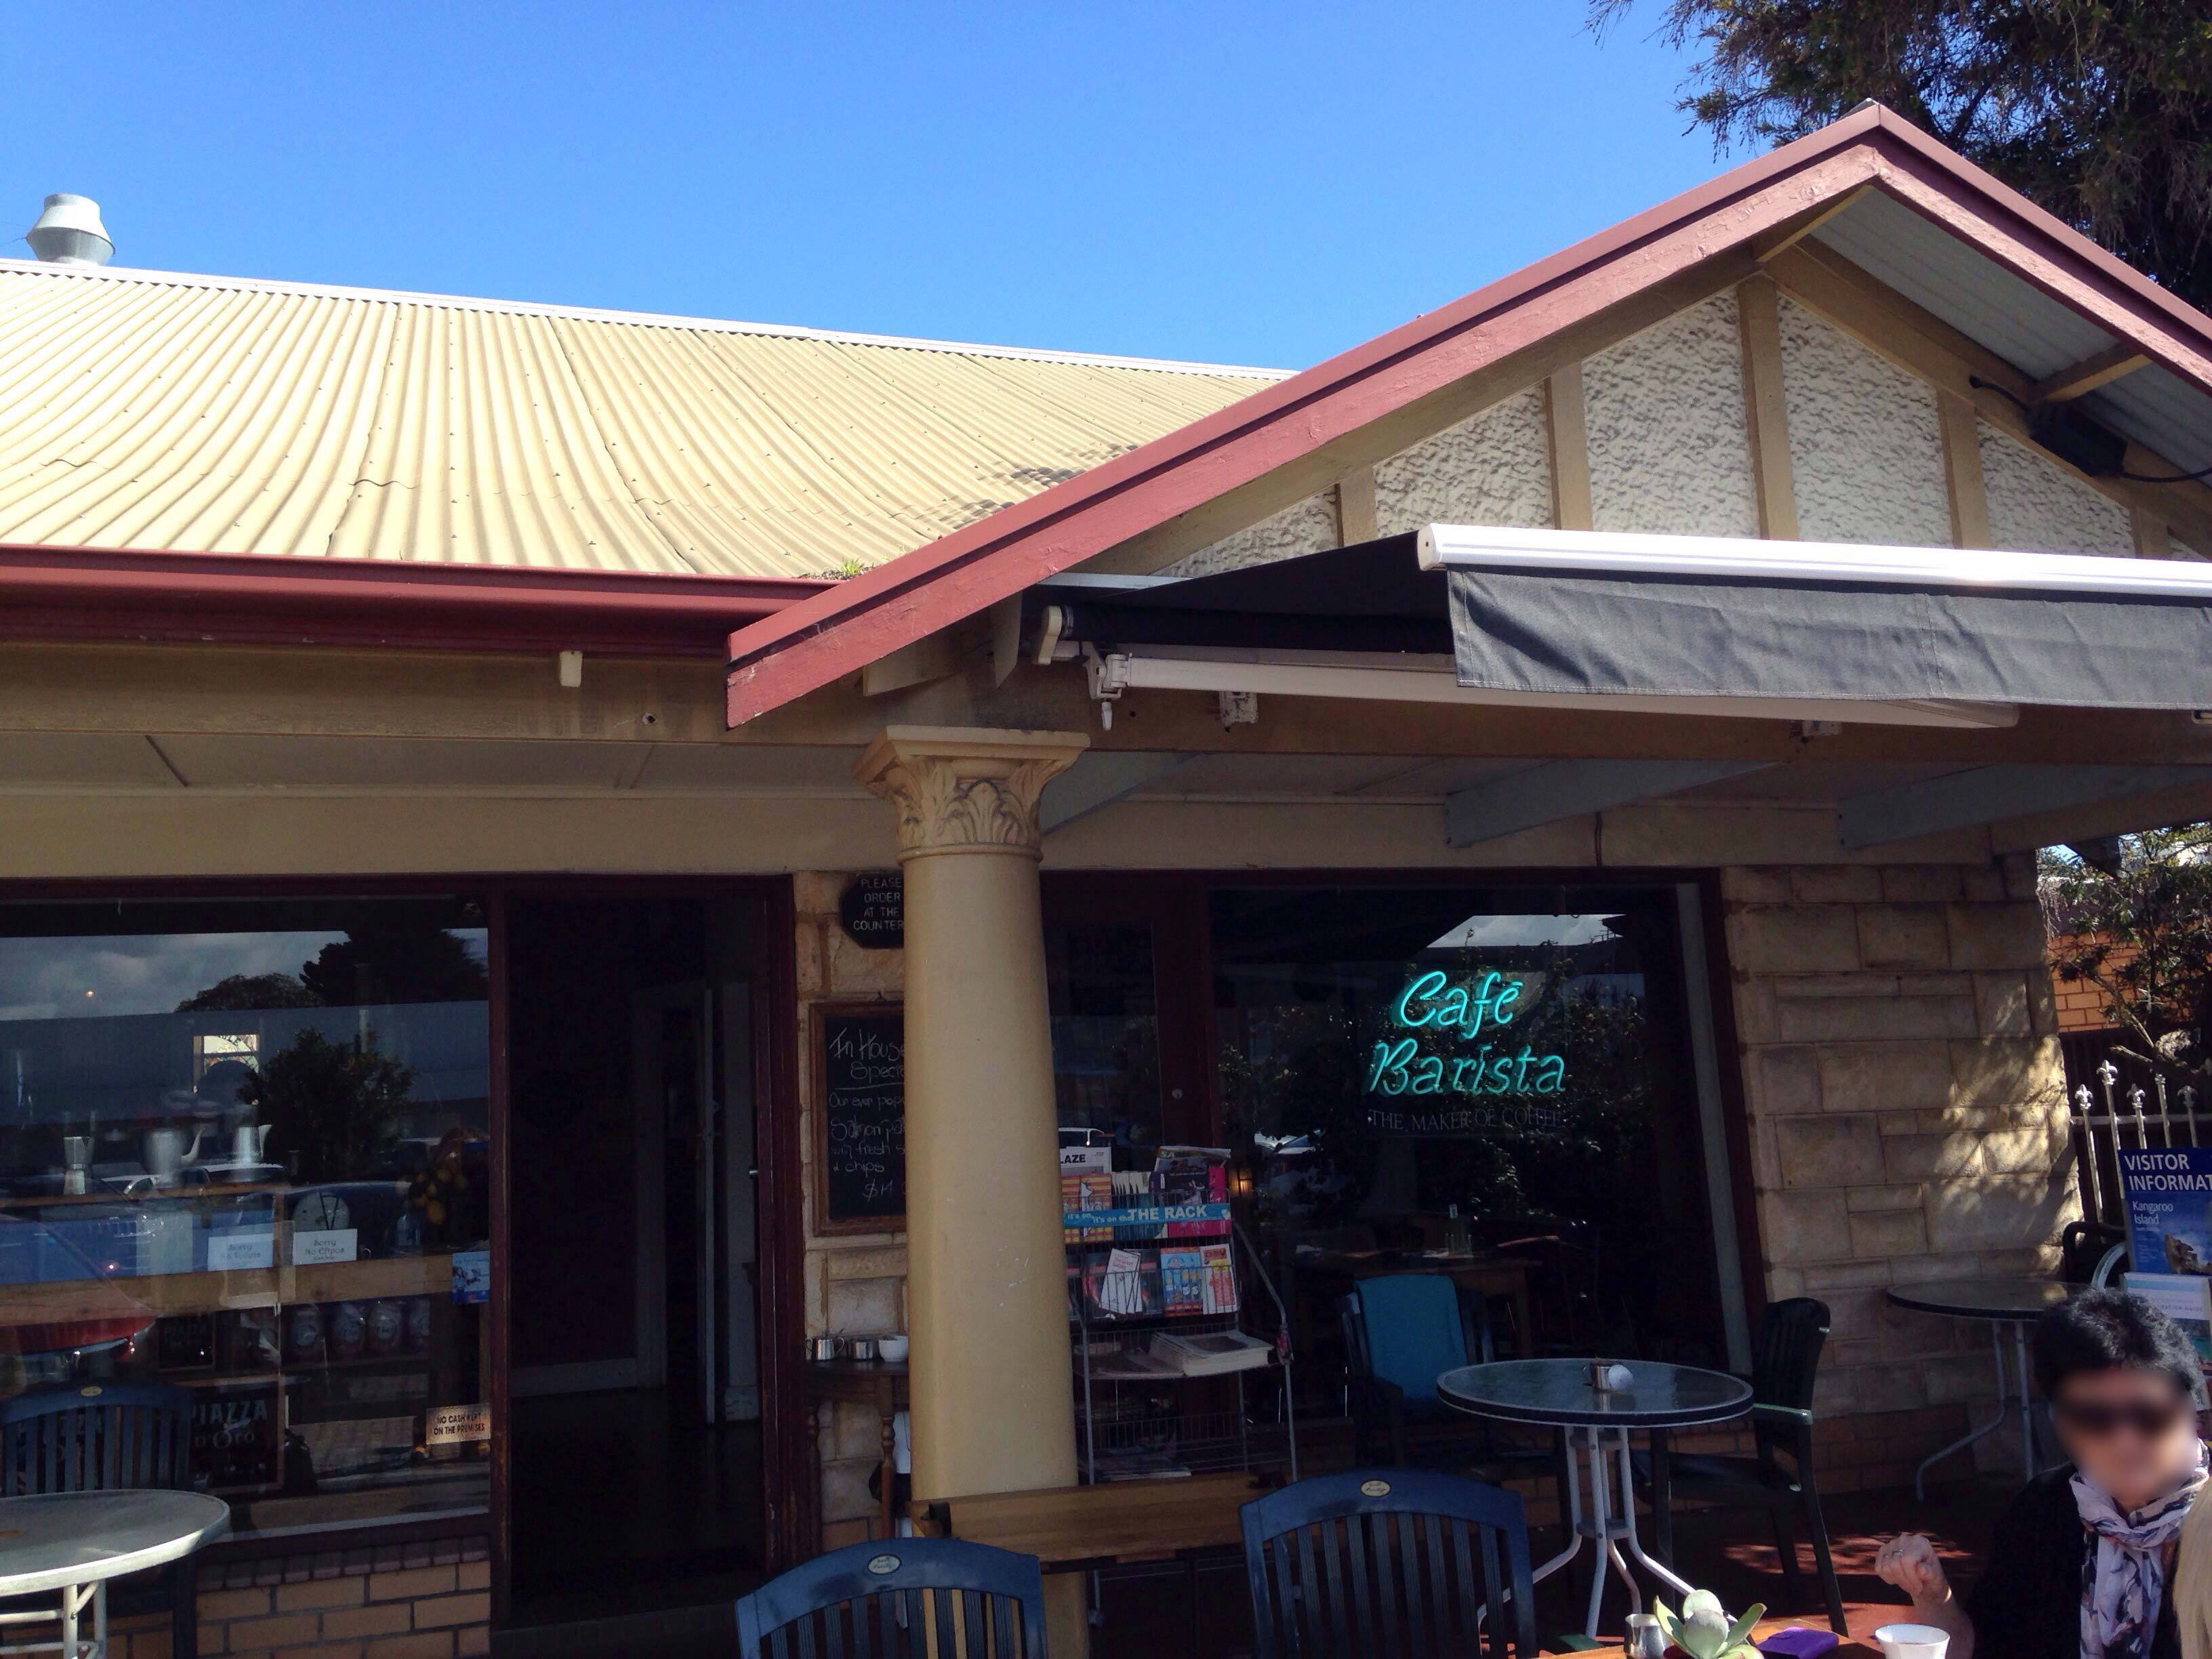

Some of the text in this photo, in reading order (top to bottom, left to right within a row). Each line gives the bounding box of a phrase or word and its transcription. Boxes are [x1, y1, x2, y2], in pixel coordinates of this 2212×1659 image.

[861, 878, 902, 888] PLEASE
[863, 892, 901, 903] ORDER
[863, 906, 900, 918] AT THE
[829, 1026, 854, 1059] In
[1368, 1038, 1566, 1095] Barista
[878, 1095, 904, 1112] pop
[1368, 1108, 1404, 1130] THE
[1411, 1111, 1469, 1130] MAKER
[2124, 1153, 2190, 1171] VISITOR
[844, 1160, 885, 1179] chips
[1127, 1205, 1208, 1222] THE RACK
[2131, 1200, 2174, 1214] Kangaroo
[2134, 1213, 2159, 1225] Island
[312, 1239, 336, 1247] Sorry
[437, 1416, 447, 1424] NO
[449, 1415, 466, 1423] CASH
[434, 1423, 485, 1435] ON THE PREMISES
